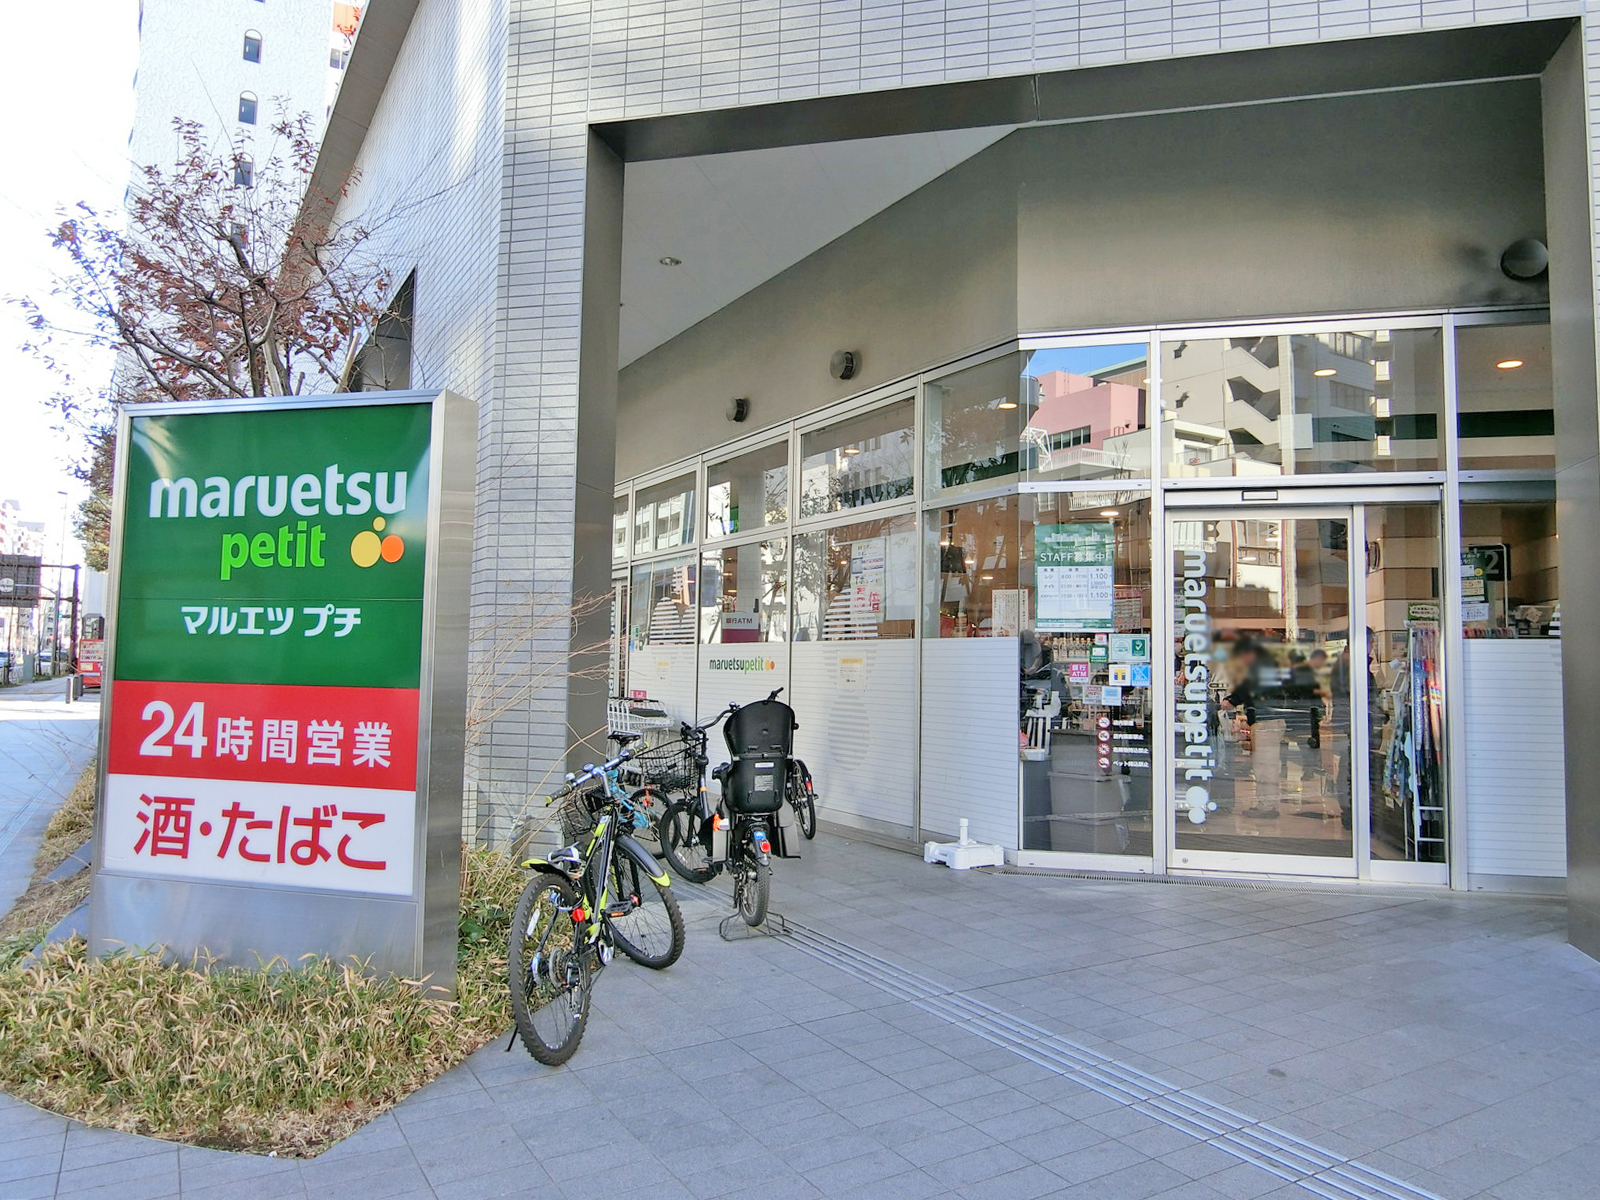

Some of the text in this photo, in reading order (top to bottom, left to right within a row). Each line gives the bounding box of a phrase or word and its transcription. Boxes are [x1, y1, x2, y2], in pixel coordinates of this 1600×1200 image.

[148, 463, 408, 519] maruetsu
[220, 520, 326, 581] petit
[181, 603, 361, 638] マルエツ プチ
[709, 656, 764, 675] maruetsupetit
[1176, 550, 1216, 780] maruetsupetit
[139, 700, 393, 768] 24時間営業
[133, 793, 387, 871] 酒・たばこ
